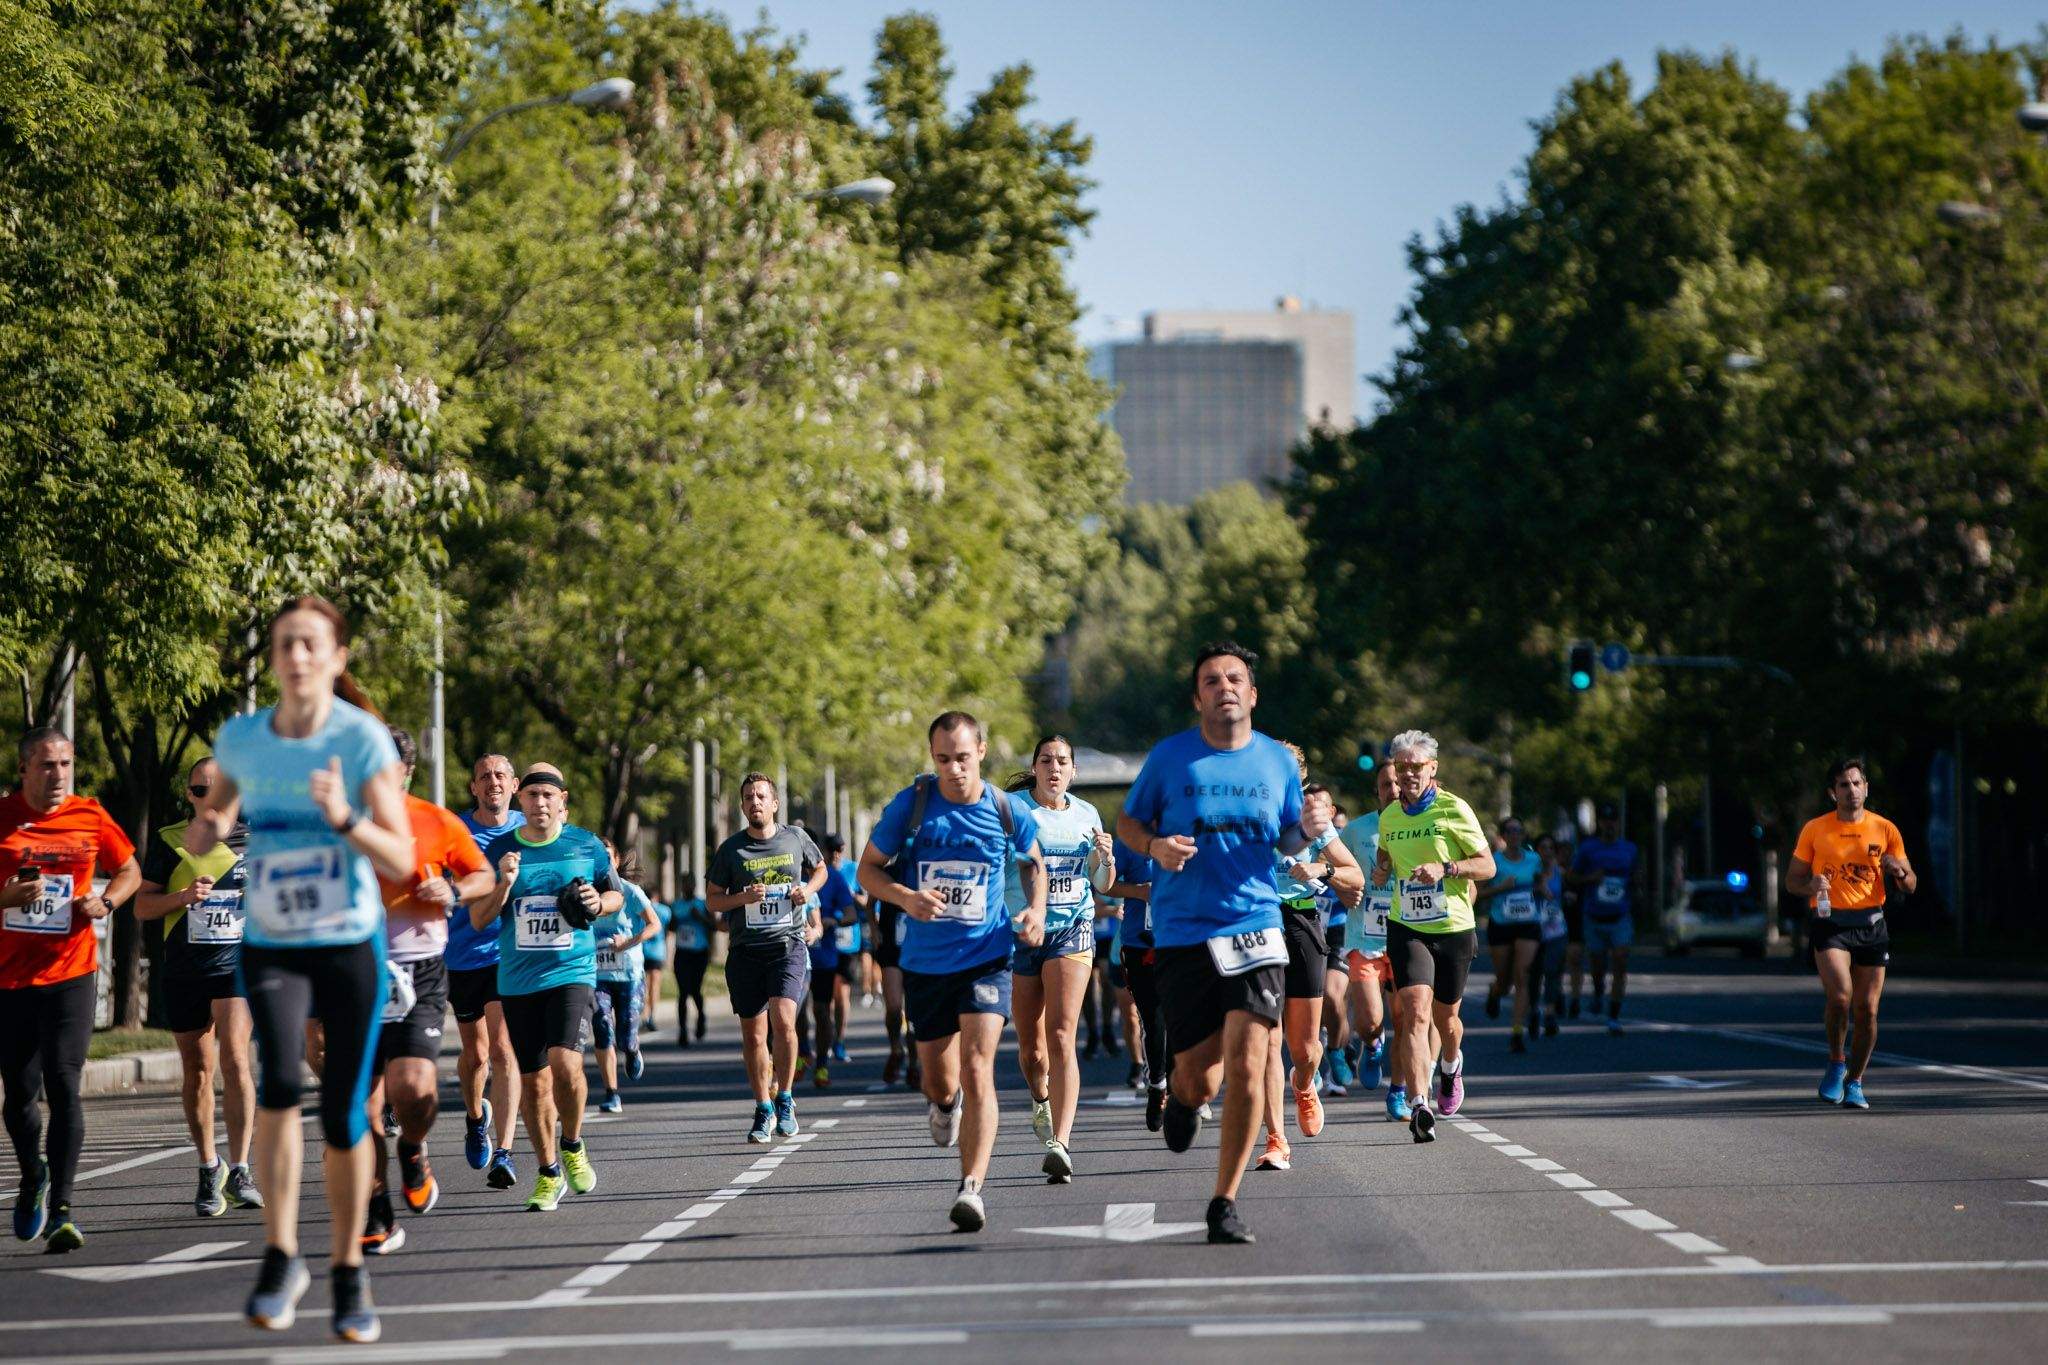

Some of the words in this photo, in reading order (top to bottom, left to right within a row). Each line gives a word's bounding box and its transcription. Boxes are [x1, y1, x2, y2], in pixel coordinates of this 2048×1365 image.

[1184, 784, 1270, 800] DECIMAS
[1386, 828, 1442, 841] DECIMAS
[1049, 877, 1072, 893] 819
[933, 885, 973, 906] 682
[1410, 896, 1432, 911] 743
[760, 902, 779, 915] 671
[206, 912, 230, 928] 744
[527, 919, 560, 935] 1744
[1233, 931, 1266, 951] 488
